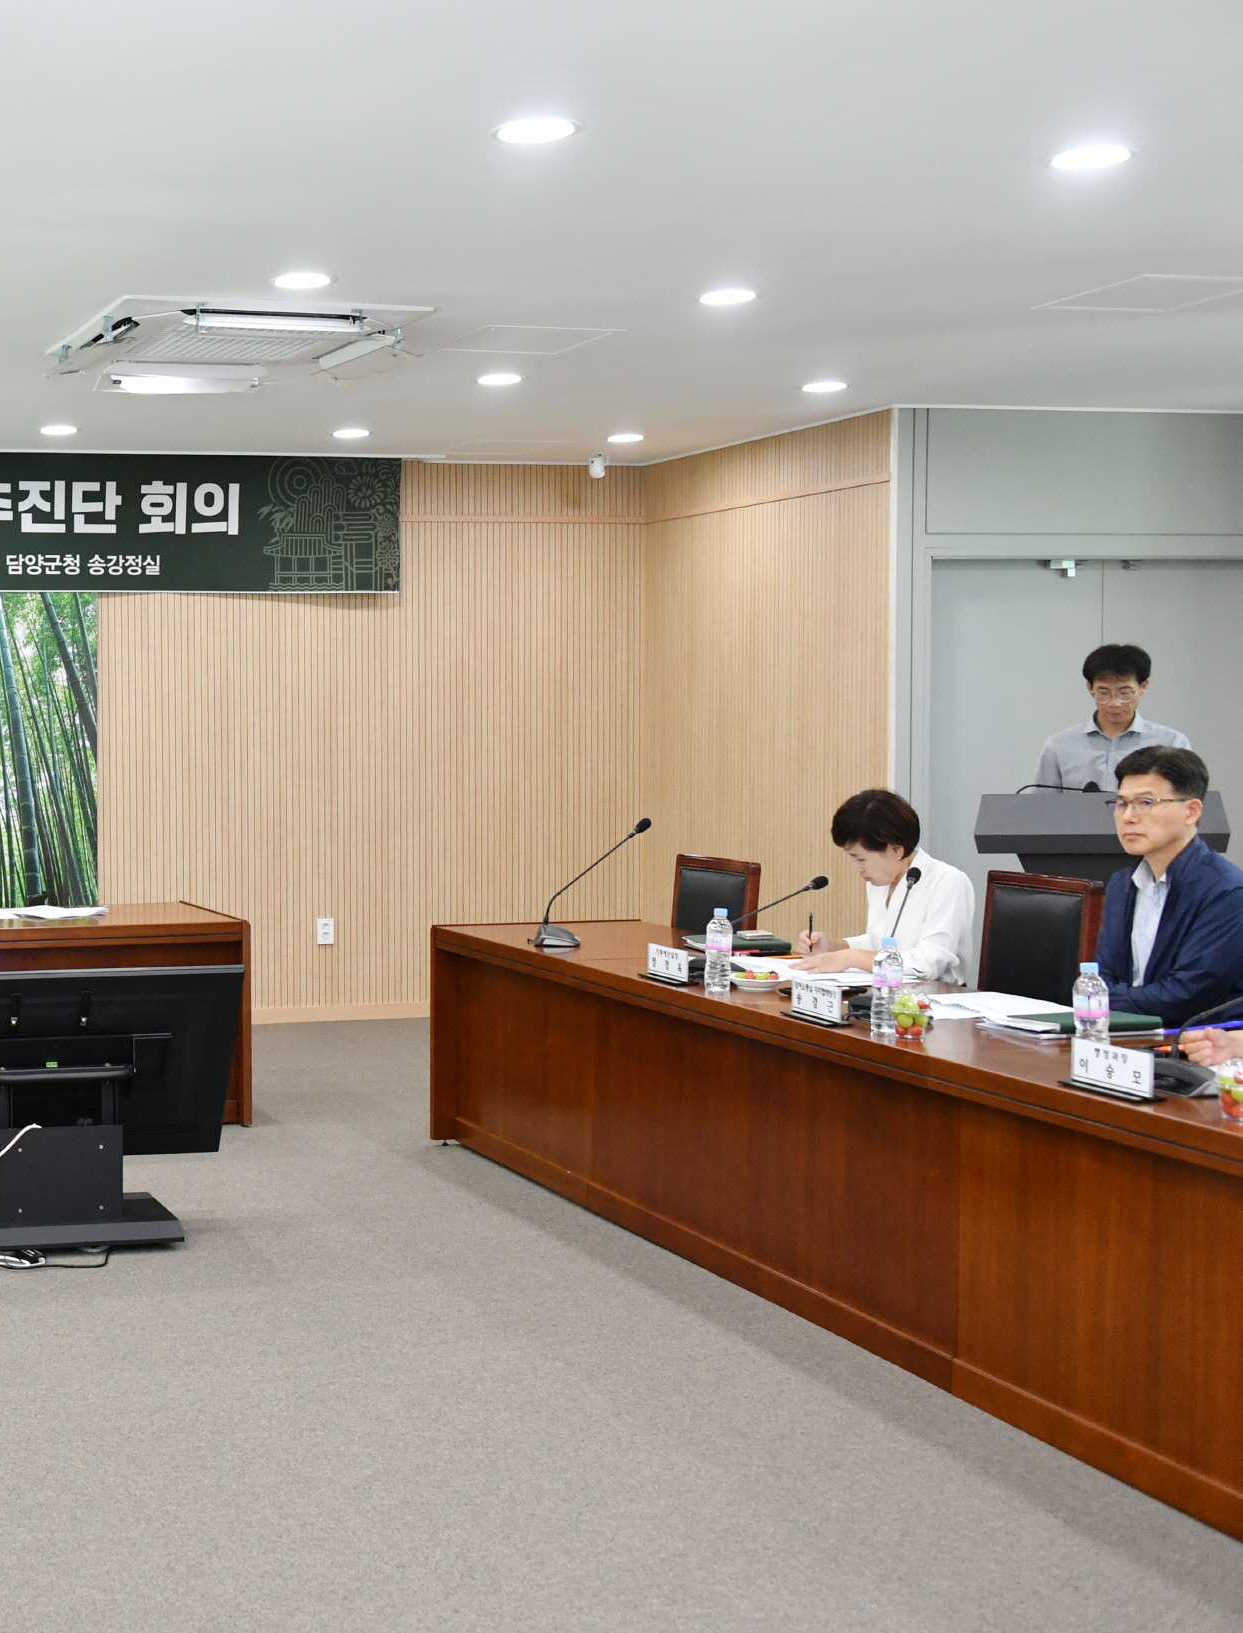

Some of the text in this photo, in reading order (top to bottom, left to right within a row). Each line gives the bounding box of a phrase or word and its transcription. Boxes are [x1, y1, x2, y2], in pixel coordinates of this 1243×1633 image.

[138, 480, 241, 536] 회의
[5, 554, 82, 577] 담양군청
[87, 554, 161, 577] 송강정실
